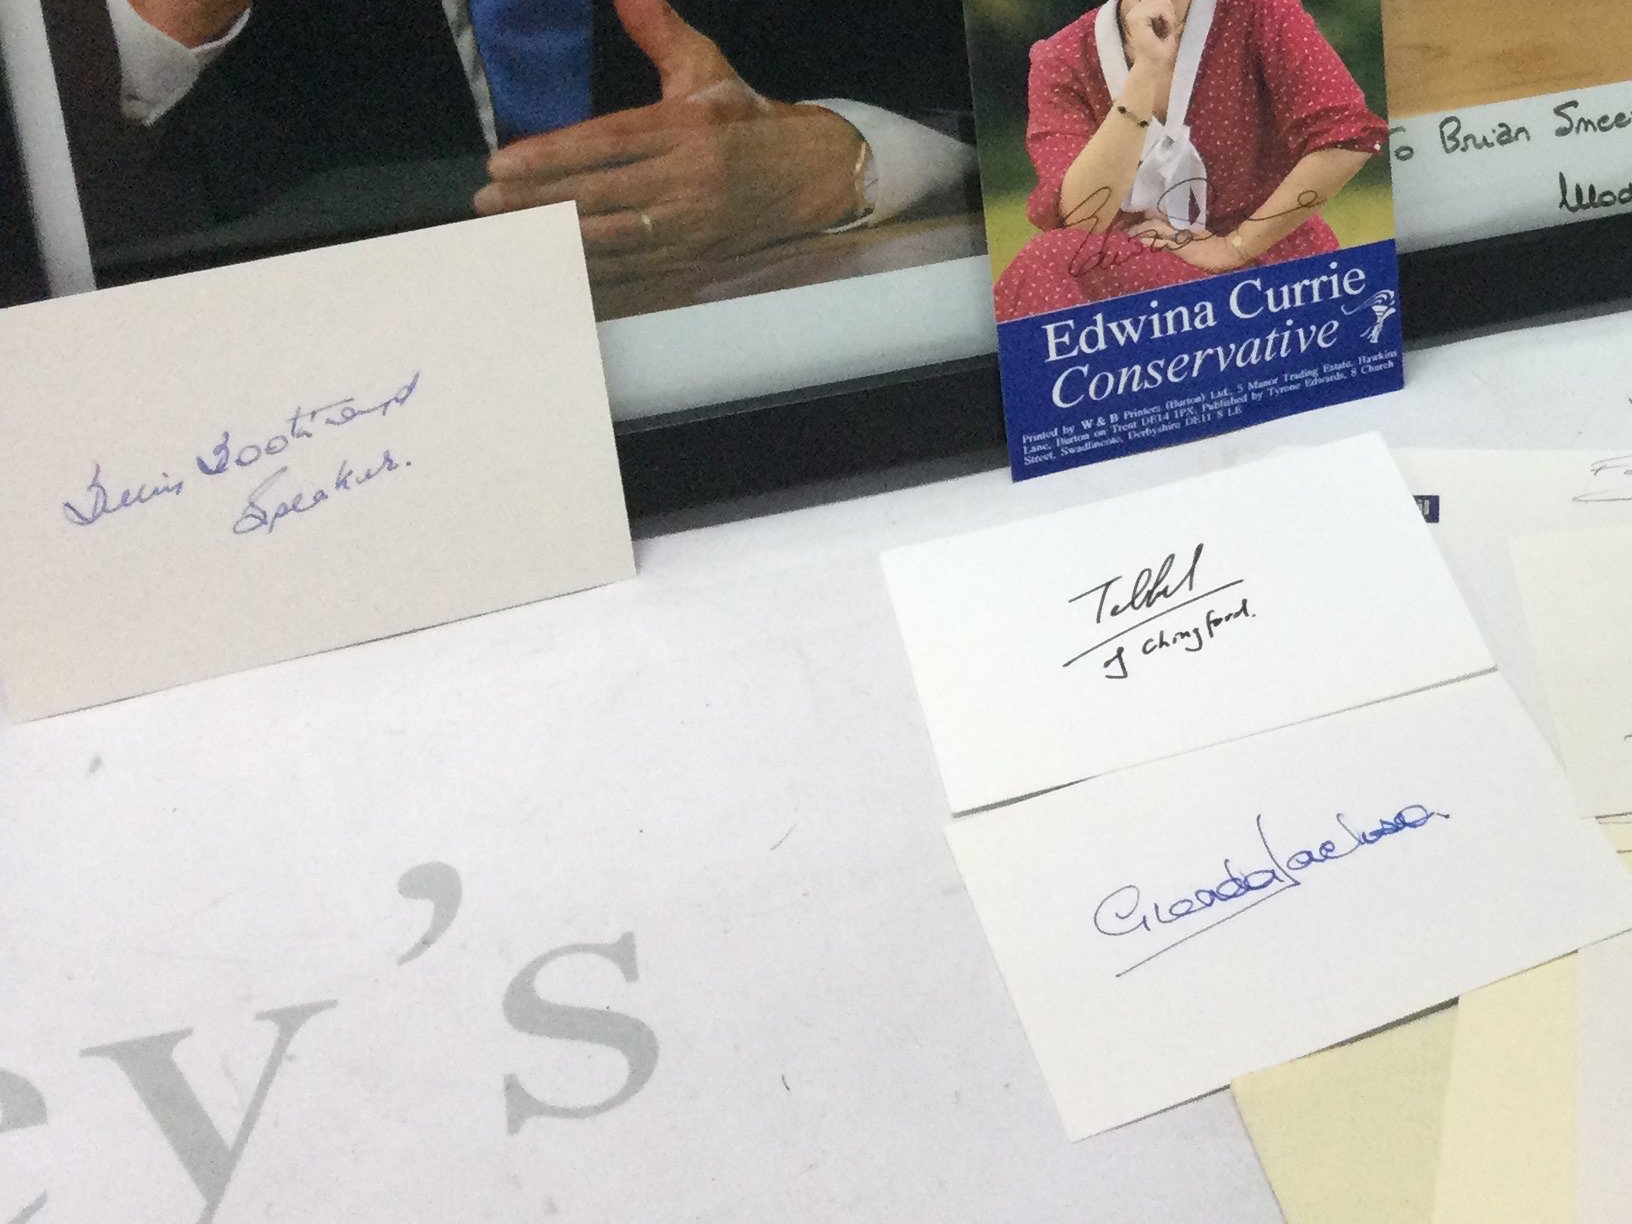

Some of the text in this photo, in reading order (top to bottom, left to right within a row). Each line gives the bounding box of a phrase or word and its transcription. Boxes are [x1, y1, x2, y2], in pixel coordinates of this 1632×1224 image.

[1438, 116, 1532, 155] Brian
[1041, 261, 1366, 363] Edwina Currie
[1022, 429, 1058, 444] Printed
[1062, 424, 1076, 436] by
[1080, 418, 1095, 429] W
[1096, 415, 1106, 427] &
[1109, 413, 1119, 424] B
[1284, 367, 1319, 383] Trading
[1358, 350, 1398, 365] Hawkins
[1052, 319, 1339, 409] Conservative
[1056, 432, 1090, 447] Burton
[1094, 428, 1106, 438] on
[1111, 421, 1137, 434] Trent
[1201, 394, 1248, 413] Published
[1251, 391, 1264, 402] by
[1267, 383, 1301, 397] Tyrone
[1360, 360, 1394, 375] Church
